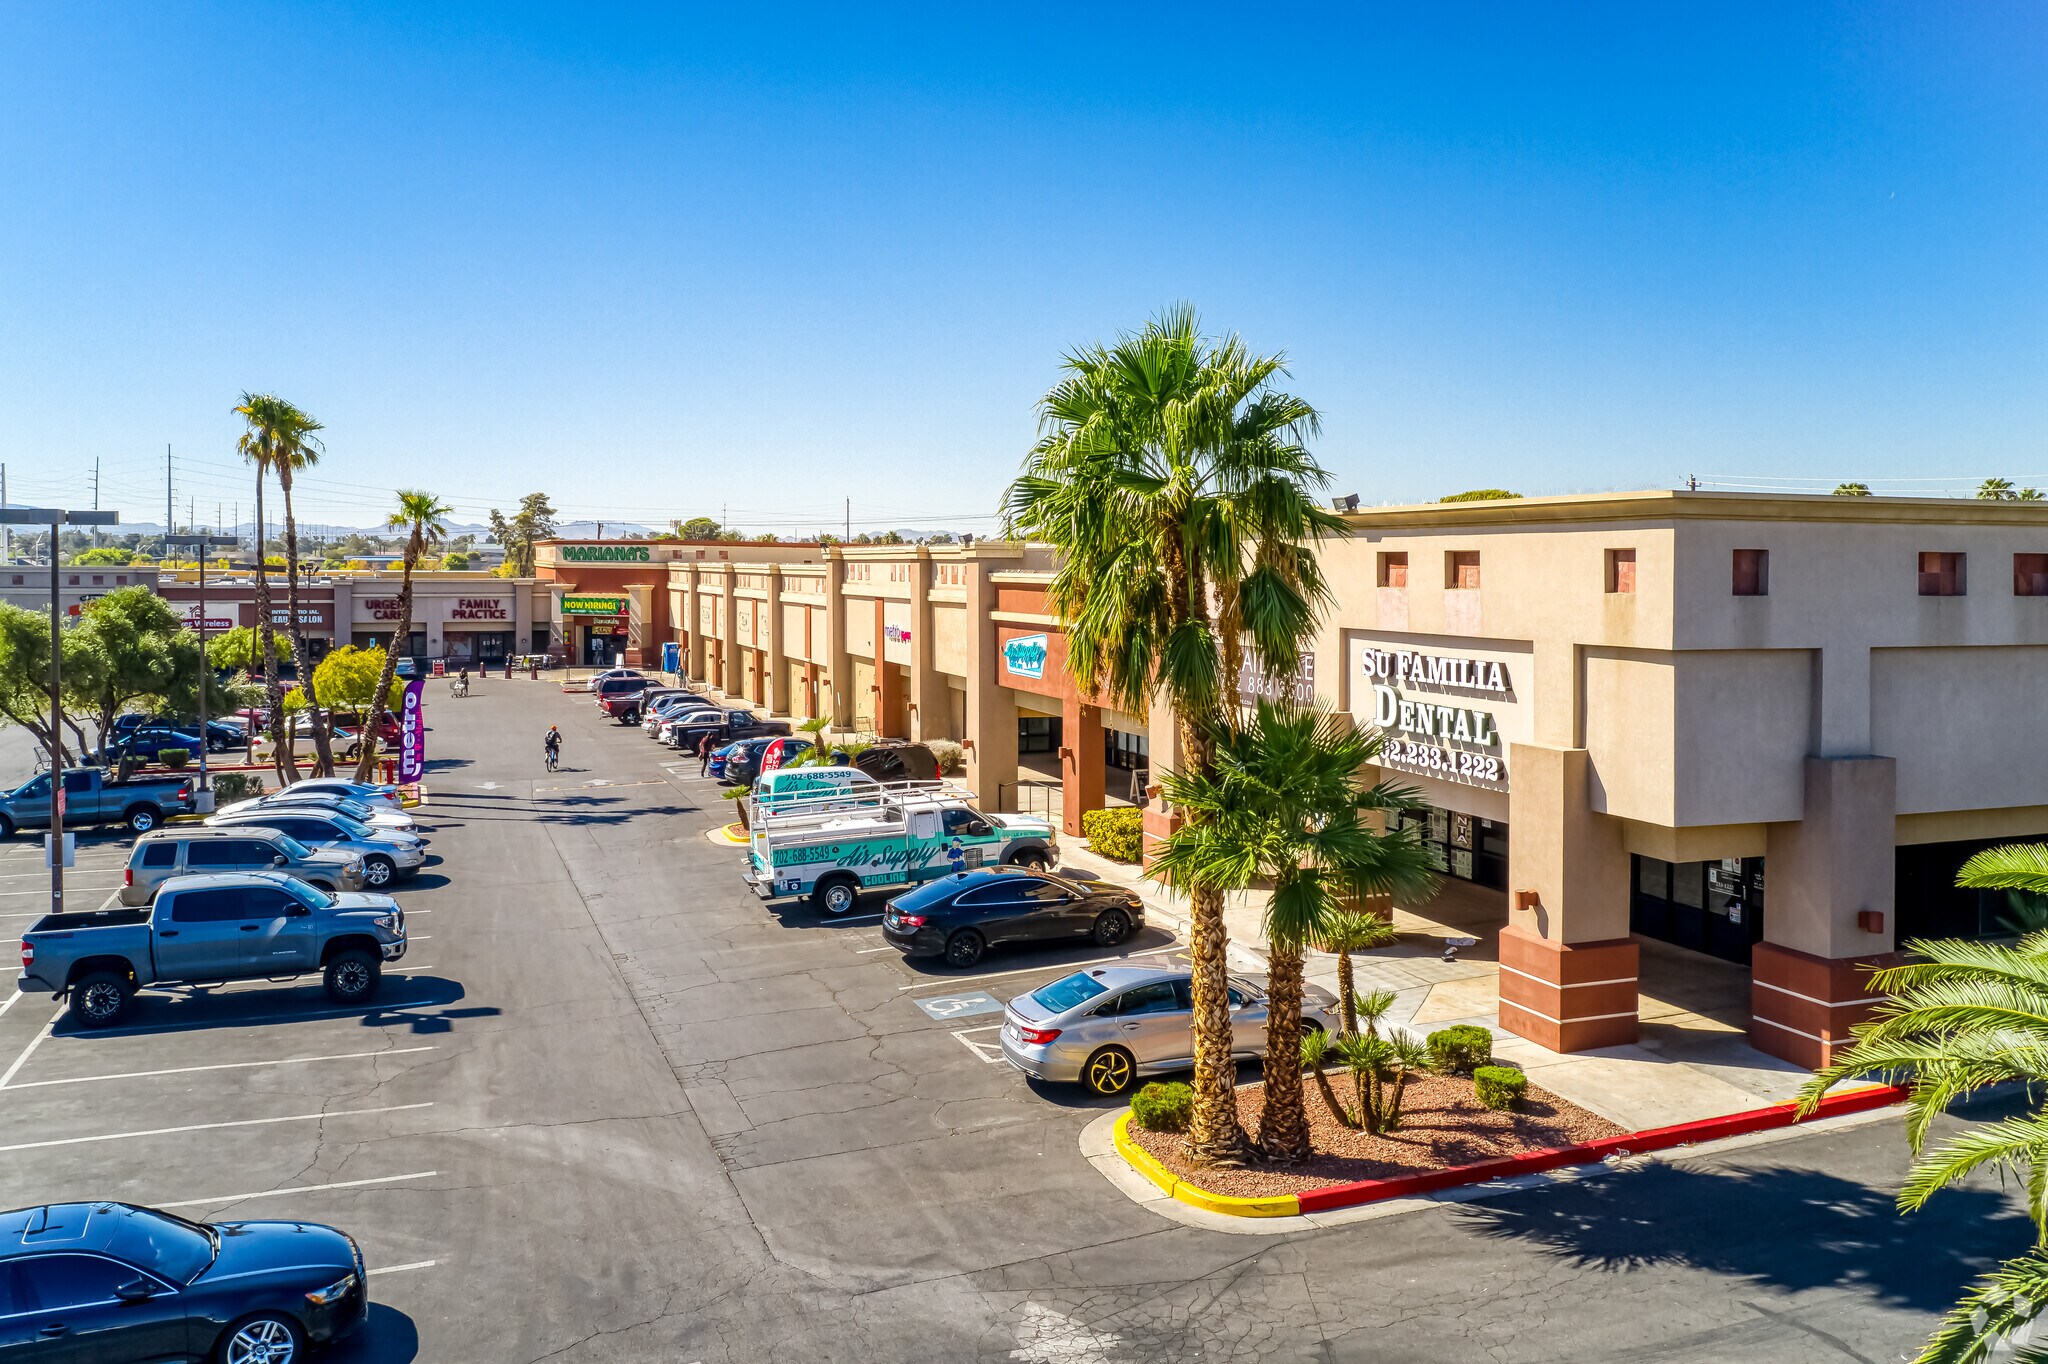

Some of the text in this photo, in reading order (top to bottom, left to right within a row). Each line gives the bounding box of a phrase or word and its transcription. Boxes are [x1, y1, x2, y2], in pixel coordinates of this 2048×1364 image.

[562, 546, 650, 561] MARIANA'S
[458, 599, 500, 609] FAMILY
[564, 601, 585, 610] NOW
[585, 602, 616, 611] HIRING!
[452, 609, 506, 619] PRACTICE
[1361, 648, 1509, 692] SU FAMILIA
[1373, 684, 1497, 746] DENTAL
[402, 691, 417, 775] metro
[785, 770, 852, 782] 702-688-5549
[774, 850, 830, 864] 702-688-5549
[836, 842, 941, 871] Air Supply
[864, 872, 906, 886] COOLING
